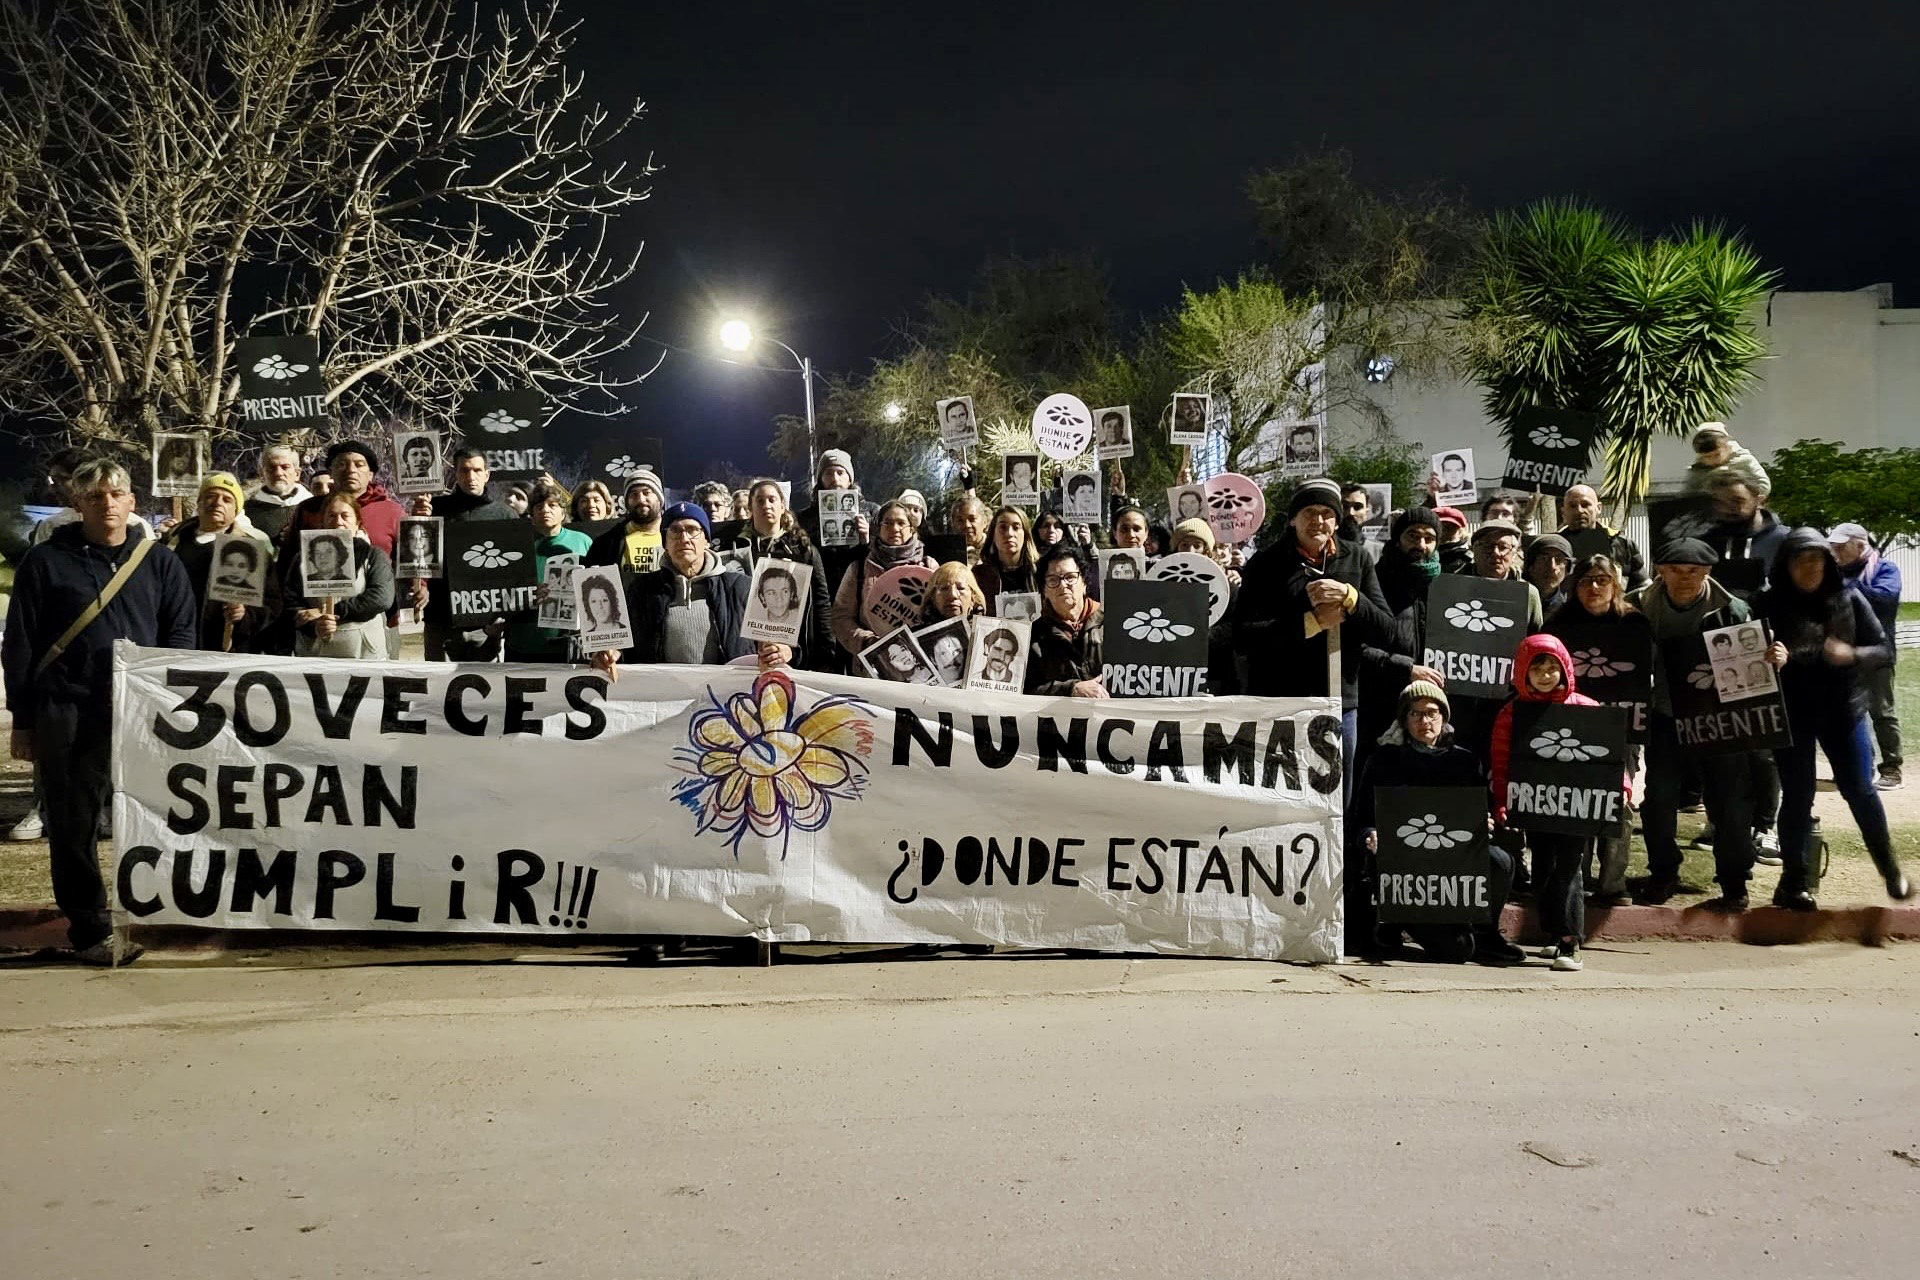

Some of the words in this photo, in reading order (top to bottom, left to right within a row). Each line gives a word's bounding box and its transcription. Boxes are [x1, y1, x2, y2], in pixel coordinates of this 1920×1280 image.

[243, 394, 329, 420] PRESENTE
[485, 448, 545, 471] ESENTE
[1504, 457, 1585, 487] PRESENTE
[450, 586, 538, 615] PRESENTE
[1102, 663, 1209, 697] PRESENTE
[1424, 647, 1515, 686] PRESENT
[970, 680, 994, 690] DANIEL
[994, 682, 1018, 692] ALFARO
[1675, 704, 1783, 745] PRESENTE
[166, 762, 418, 835] SEPAN
[1507, 781, 1621, 823] PRESENTE
[1107, 825, 1320, 905] ESTÁN?
[1379, 873, 1489, 907] PRESENTE
